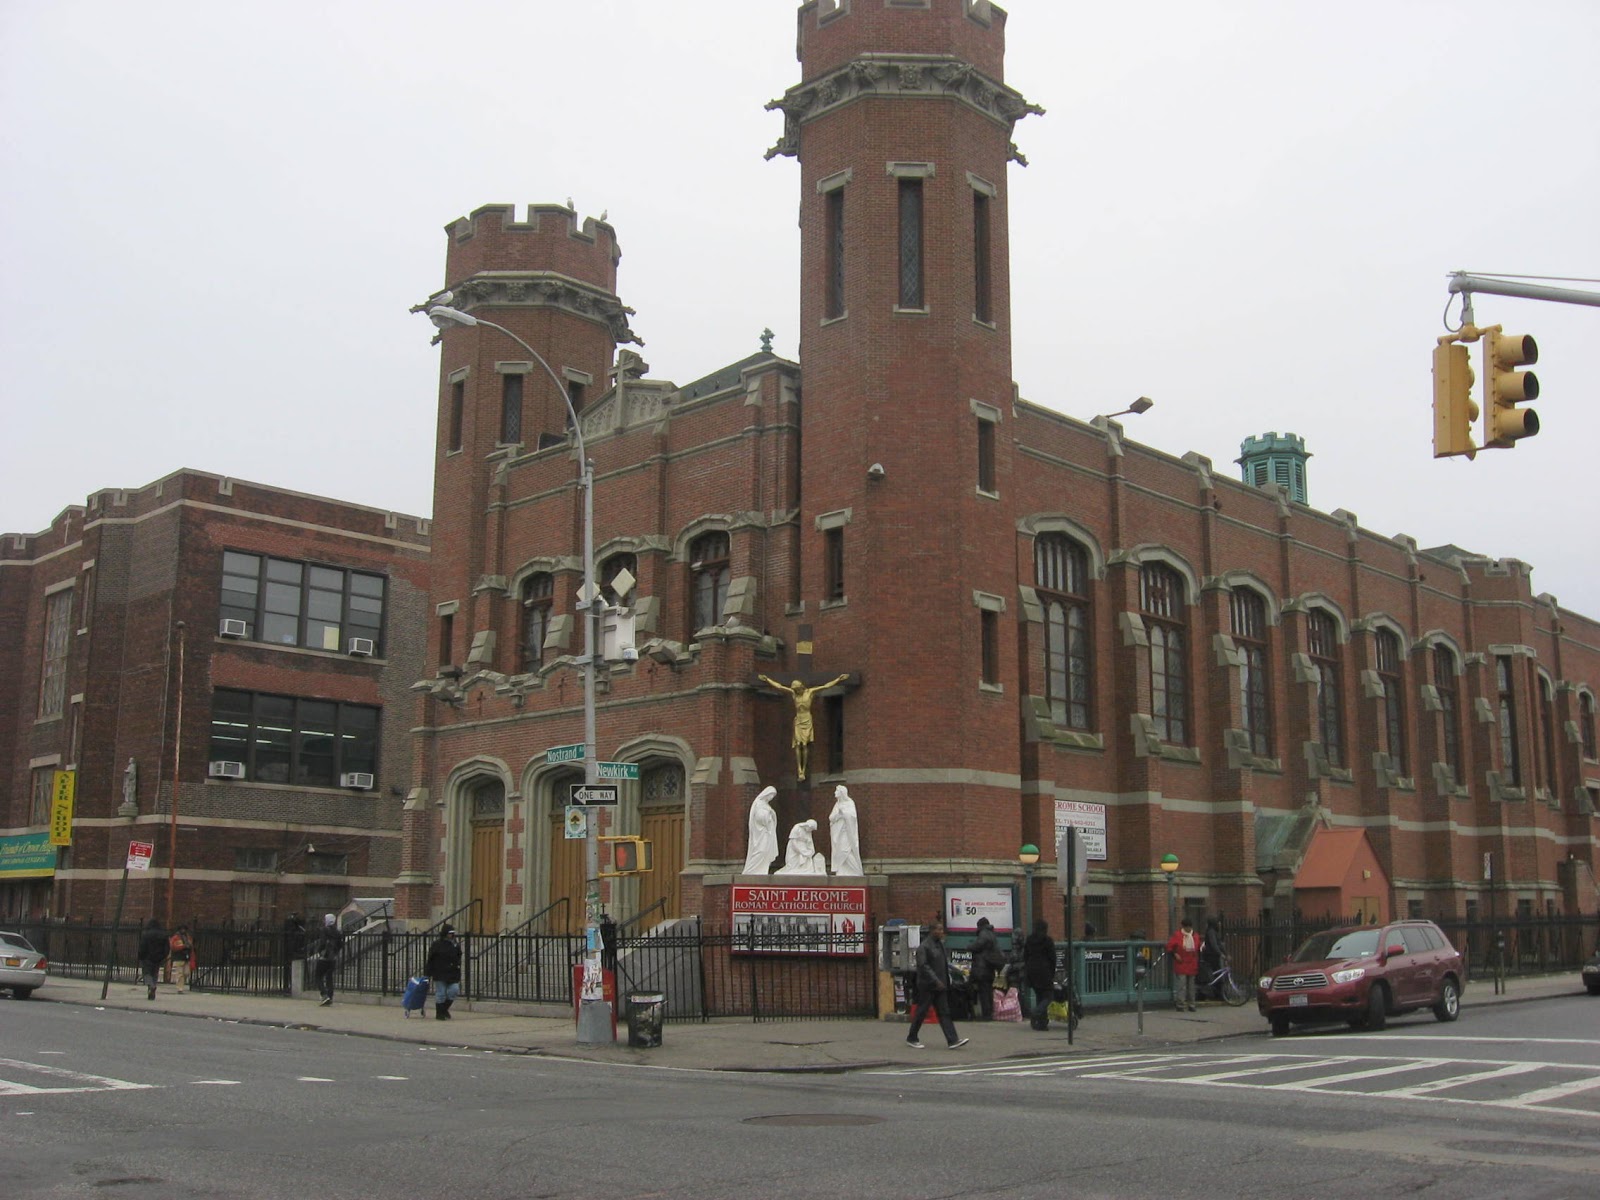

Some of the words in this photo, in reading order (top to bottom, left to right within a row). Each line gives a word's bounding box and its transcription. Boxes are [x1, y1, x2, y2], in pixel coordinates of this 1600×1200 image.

[547, 746, 577, 762] Nostrand
[597, 763, 629, 777] Newkirk
[579, 792, 594, 800] ONE
[600, 791, 613, 799] WAY
[1078, 803, 1105, 813] SCHOOL
[748, 890, 788, 901] SAINT
[793, 890, 849, 902] JEROME
[735, 901, 768, 909] ROMAN
[771, 901, 819, 910] CATHOLIC
[822, 902, 863, 911] CHURCH
[966, 906, 977, 915] 50
[951, 951, 972, 960] Newki
[1084, 951, 1103, 960] Subway
